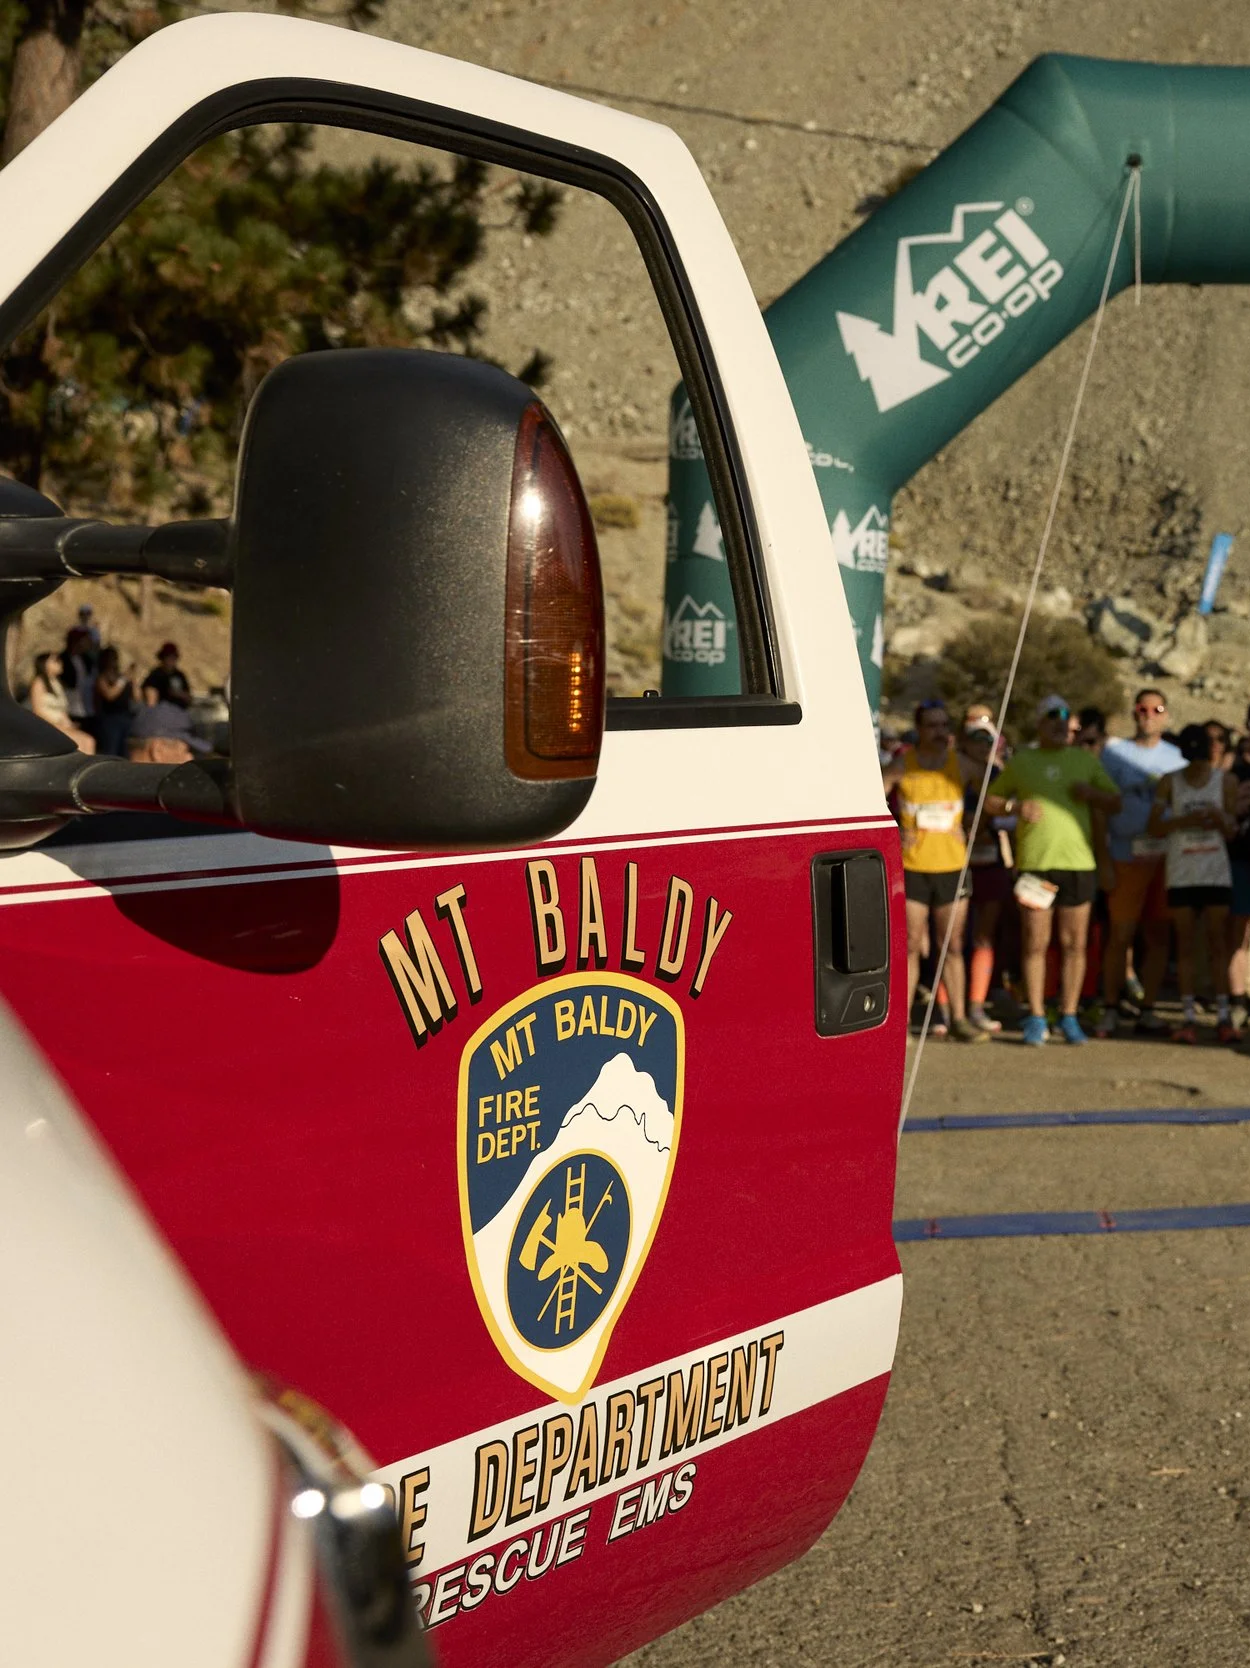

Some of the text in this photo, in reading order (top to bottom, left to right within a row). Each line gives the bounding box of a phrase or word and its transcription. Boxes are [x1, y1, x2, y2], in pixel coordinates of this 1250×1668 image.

[912, 208, 1050, 351] REI
[674, 620, 726, 649] REI
[378, 856, 733, 1049] MT BALDY
[489, 994, 660, 1081] MT BALDY
[476, 1119, 542, 1164] DEPT.
[478, 1085, 541, 1128] FIRE
[467, 1330, 785, 1544] DEPARTMENT
[606, 1462, 697, 1546] EMS
